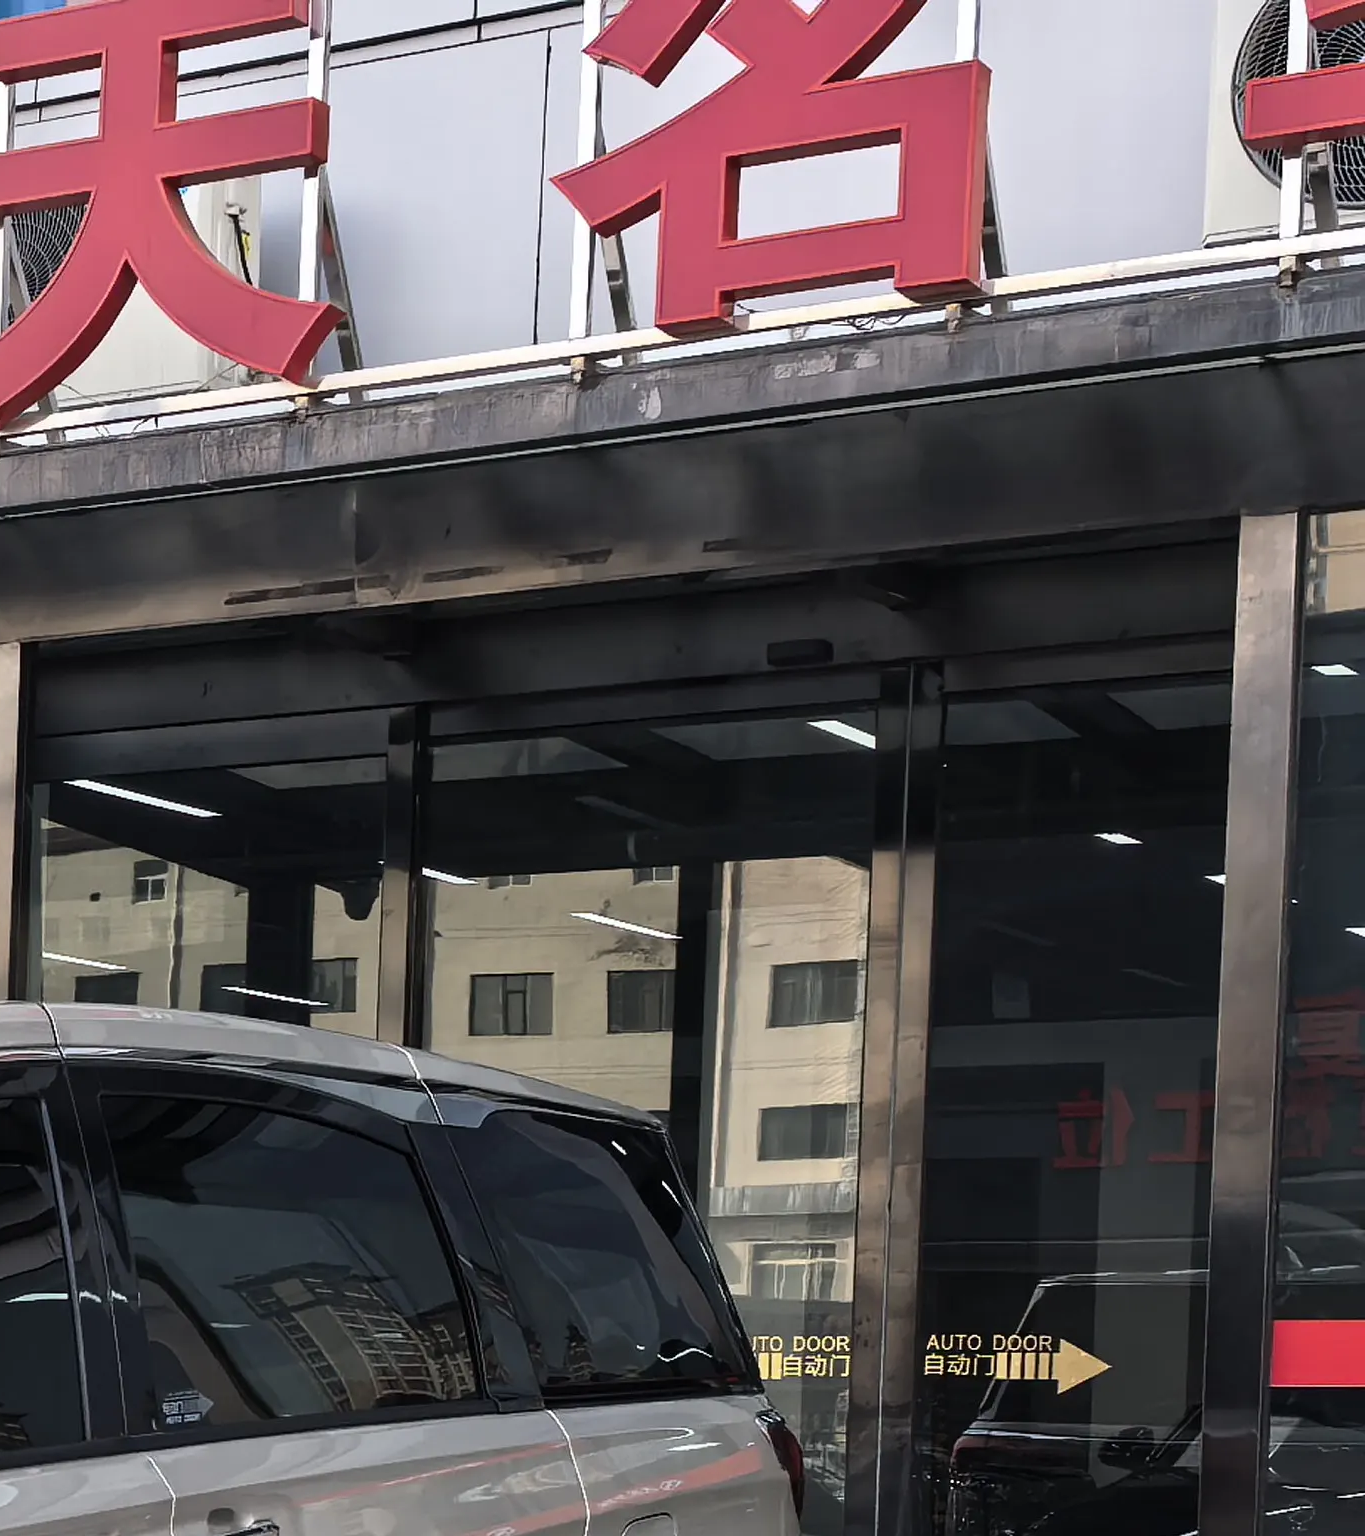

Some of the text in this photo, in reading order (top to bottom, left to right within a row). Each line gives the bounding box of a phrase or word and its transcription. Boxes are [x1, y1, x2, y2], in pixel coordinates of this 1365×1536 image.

[793, 1336, 851, 1352] DOOR
[926, 1334, 1053, 1351] AUTO DOOR
[783, 1354, 851, 1378] 自动门
[924, 1353, 996, 1377] 自动门
